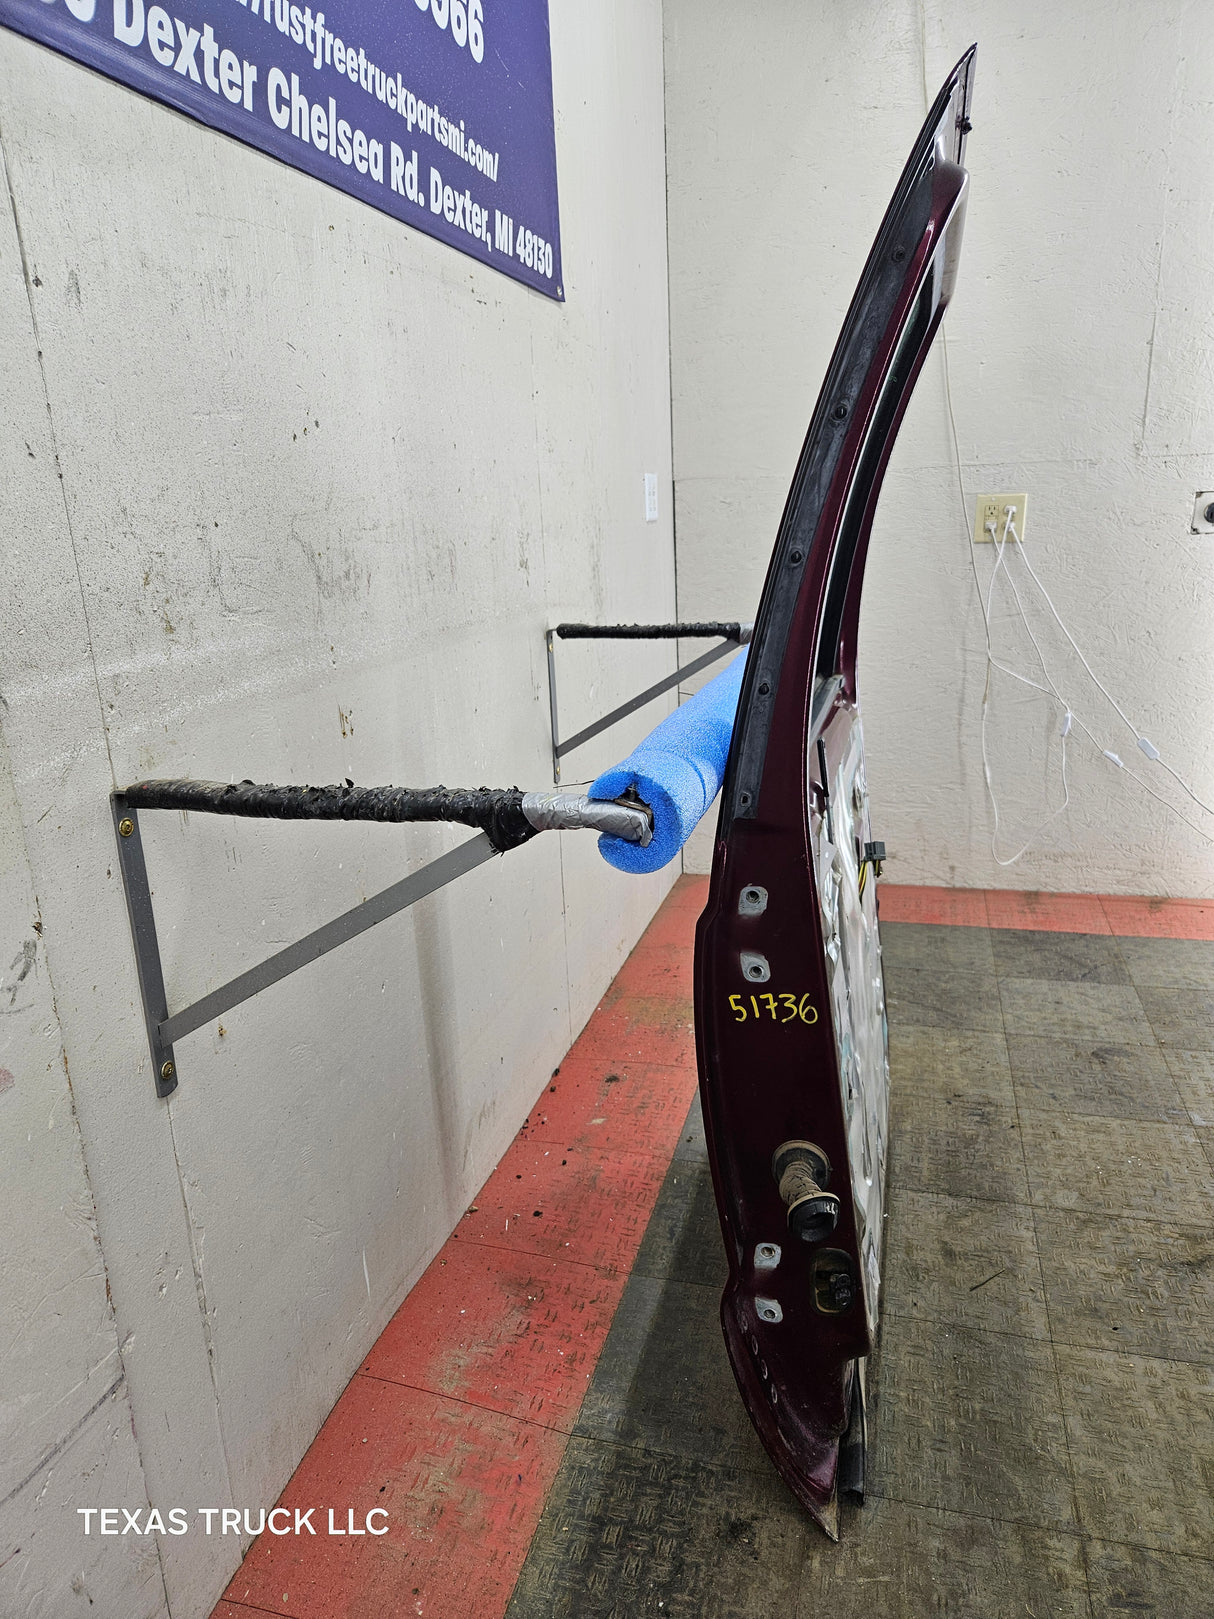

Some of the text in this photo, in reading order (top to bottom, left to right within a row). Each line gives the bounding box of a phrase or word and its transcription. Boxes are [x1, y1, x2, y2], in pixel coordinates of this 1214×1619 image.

[113, 0, 553, 279] Dexter Chelsea Rd. Dexter, MI 48130
[728, 993, 819, 1024] 51736
